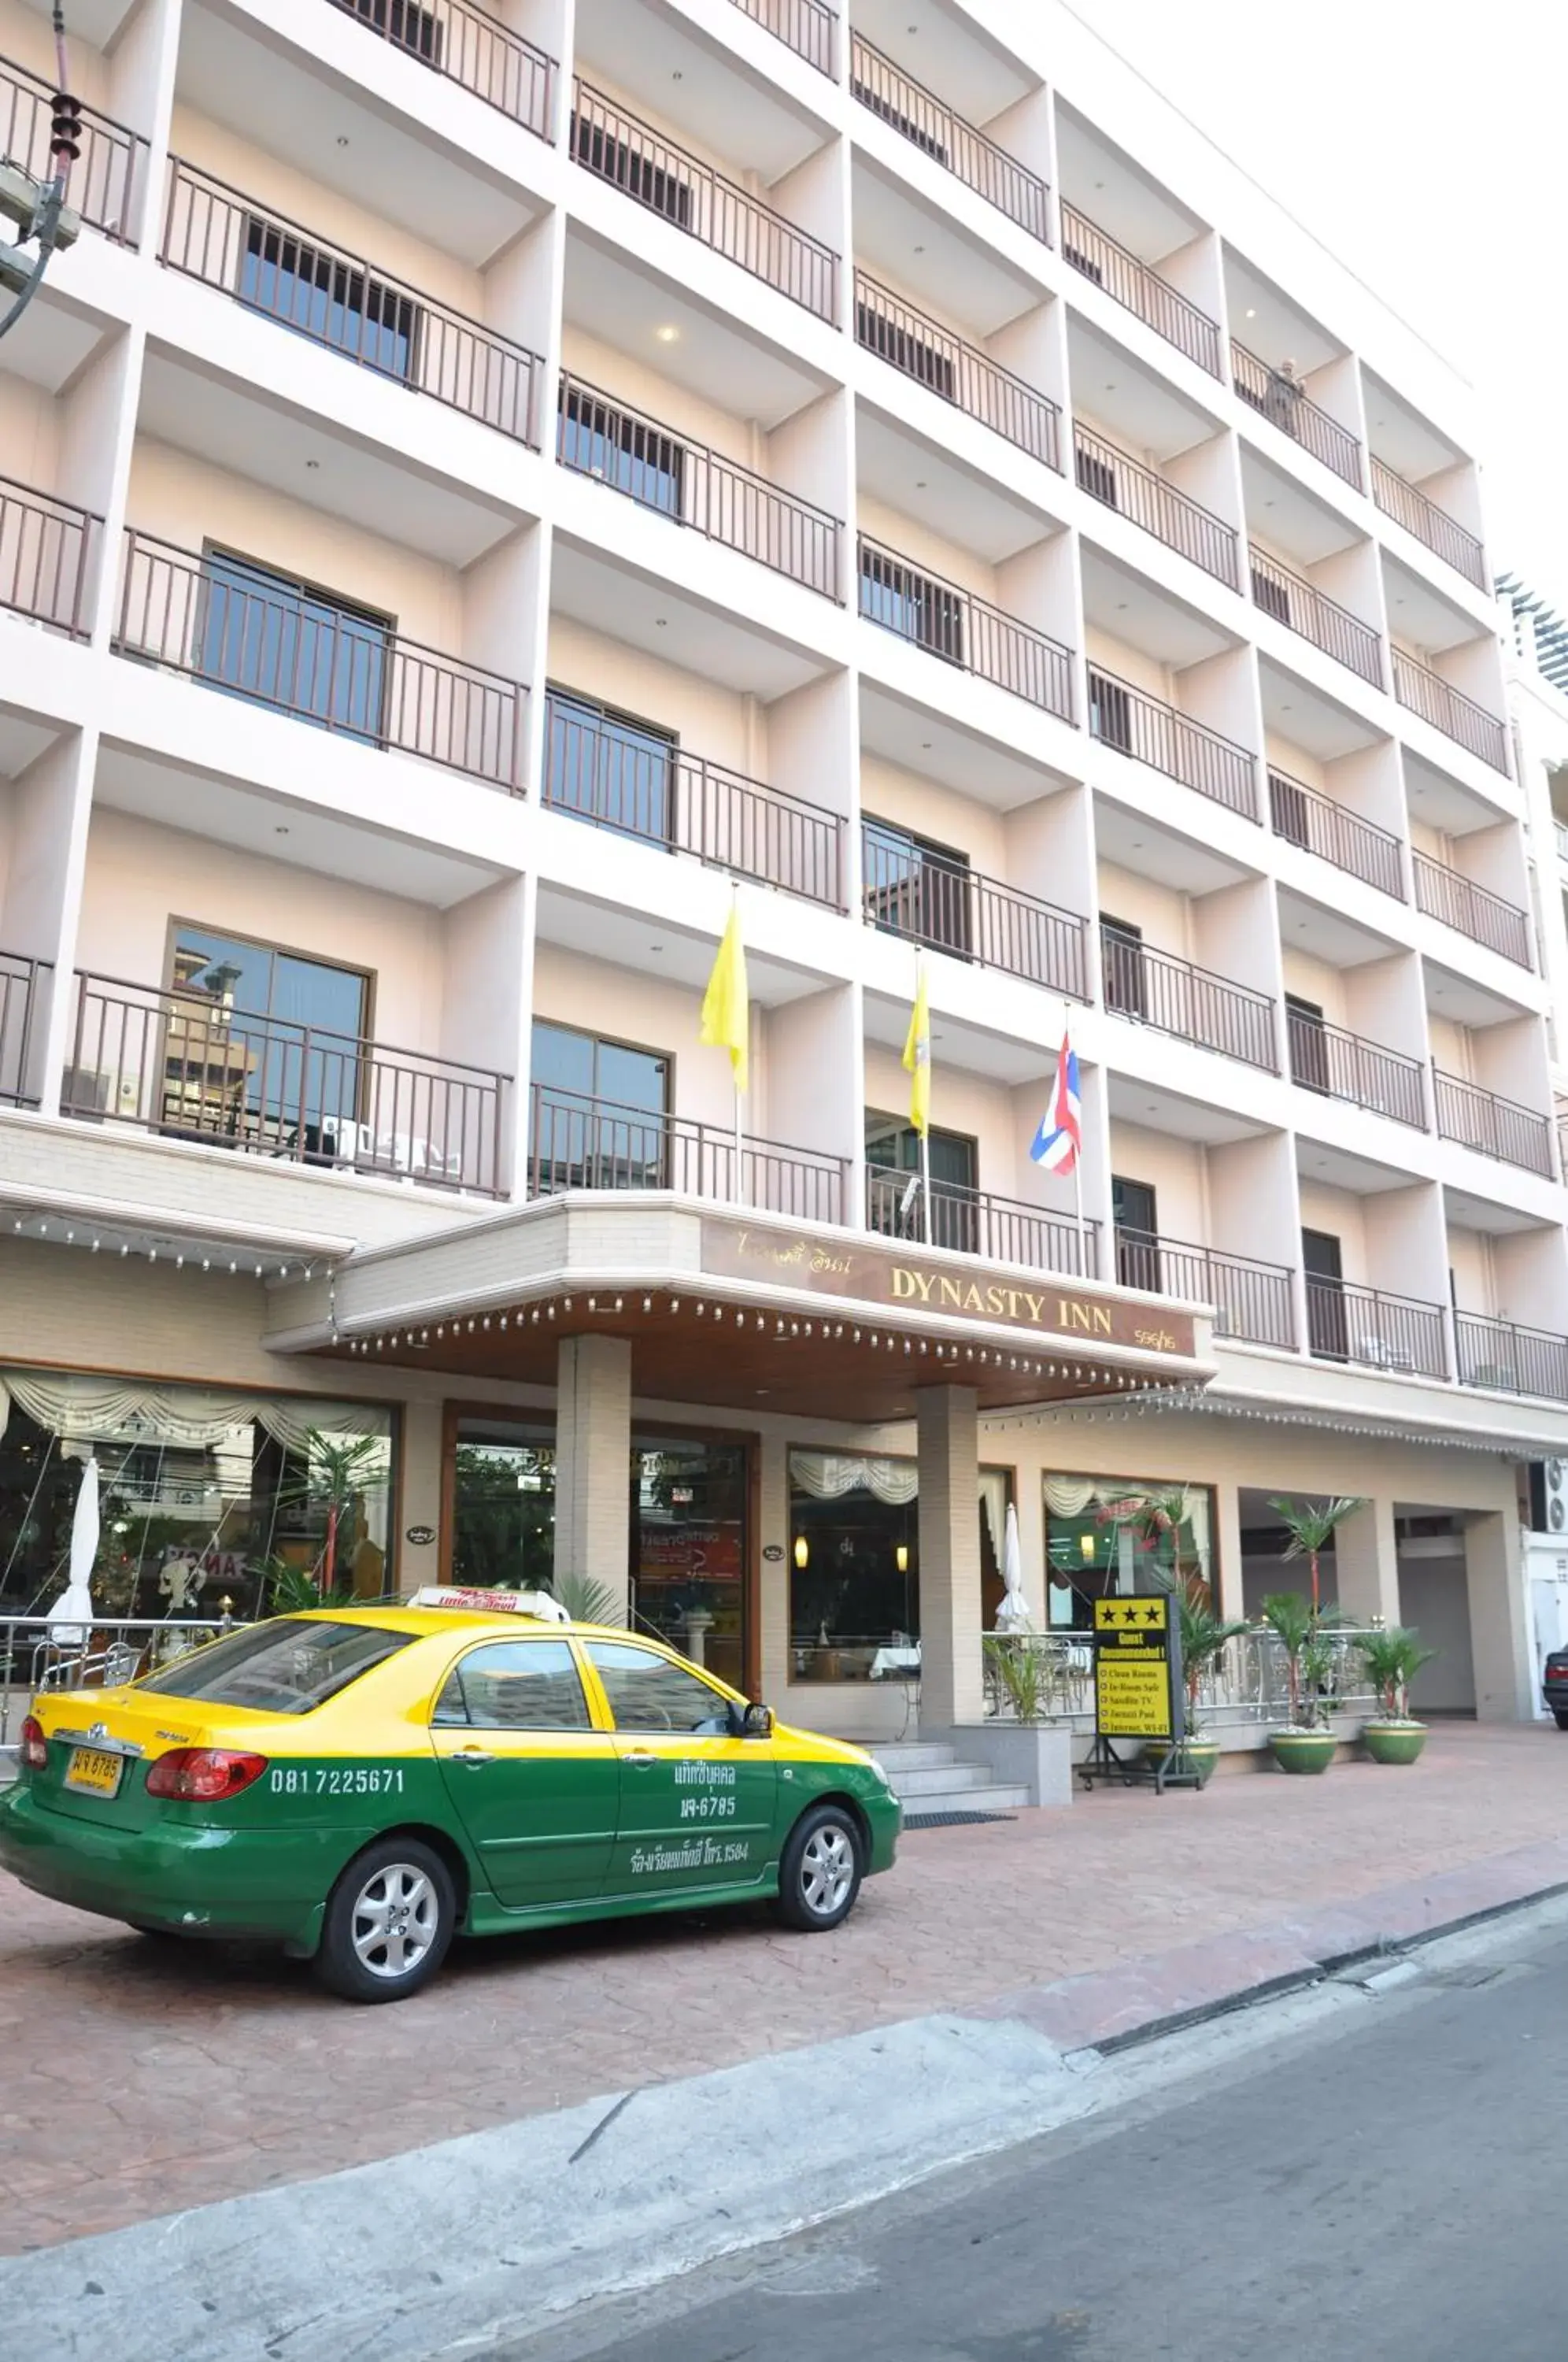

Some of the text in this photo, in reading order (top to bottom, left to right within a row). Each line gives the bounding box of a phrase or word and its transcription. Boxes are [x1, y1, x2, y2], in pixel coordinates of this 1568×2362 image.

[892, 1267, 1112, 1335] DYNASTY INN
[271, 1769, 404, 1794] 081 7225671
